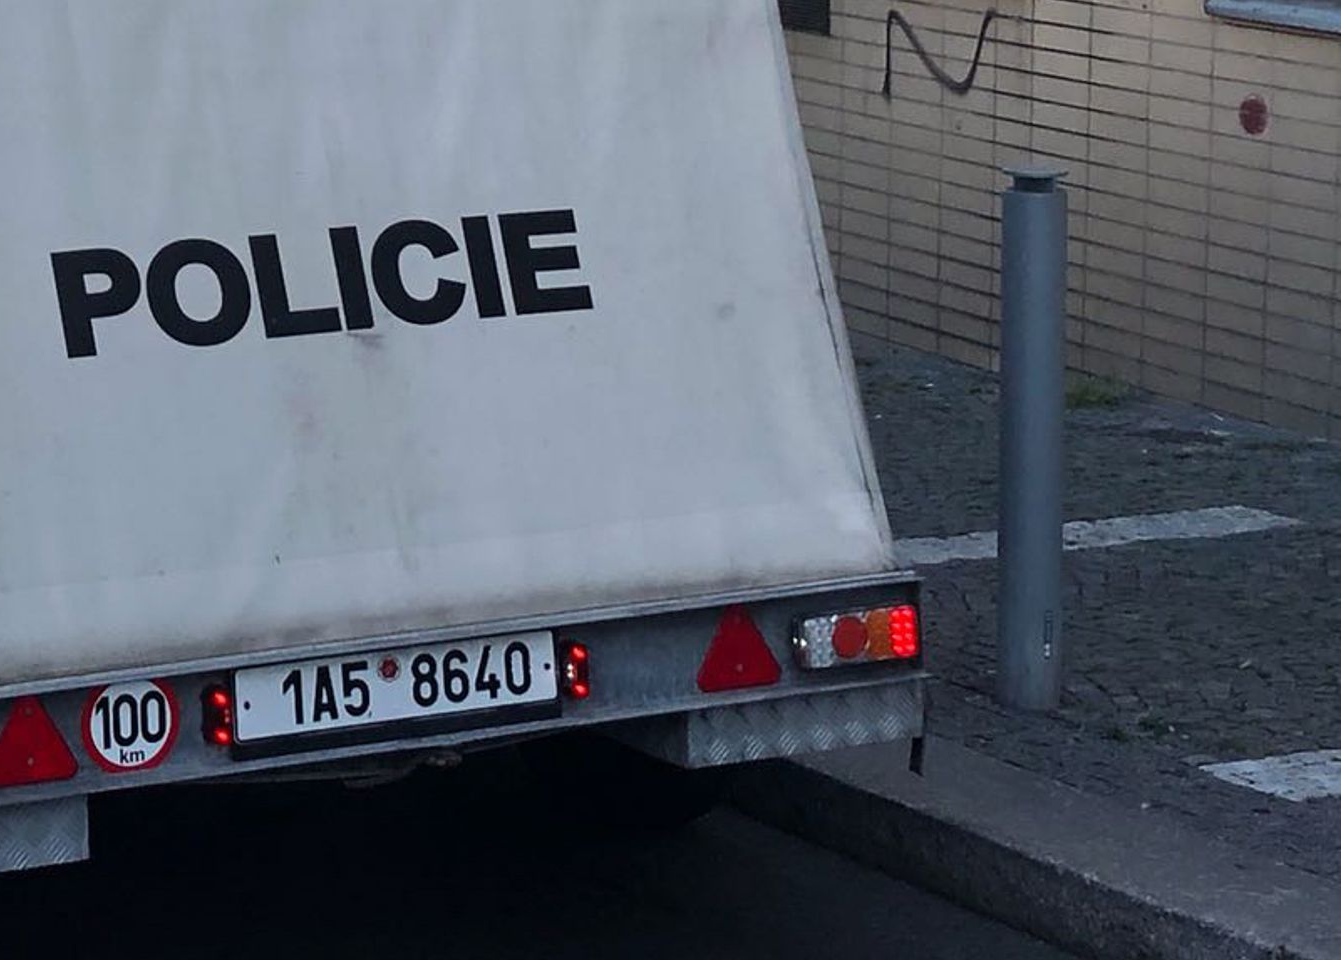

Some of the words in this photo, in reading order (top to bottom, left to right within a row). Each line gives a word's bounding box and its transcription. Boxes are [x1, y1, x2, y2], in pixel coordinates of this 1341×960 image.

[50, 209, 594, 359] POLICIE
[282, 660, 371, 725] 1A5
[411, 640, 532, 708] 8640
[95, 690, 167, 750] 100
[119, 748, 146, 764] km
